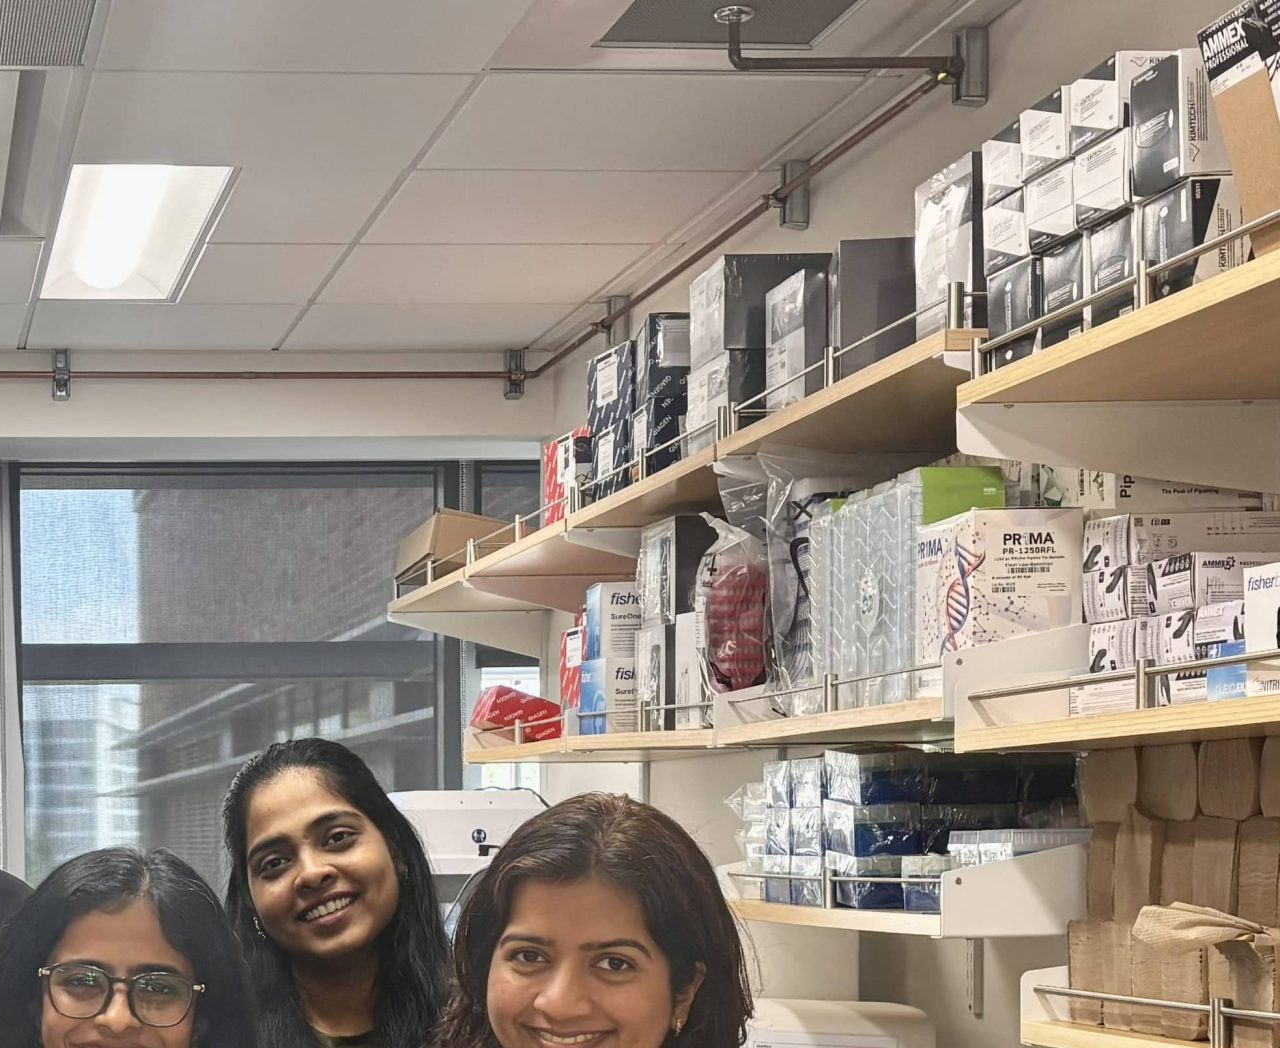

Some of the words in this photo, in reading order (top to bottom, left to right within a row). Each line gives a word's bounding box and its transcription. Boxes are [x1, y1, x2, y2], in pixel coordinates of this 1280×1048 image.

[1202, 18, 1247, 61] AMMEX
[1206, 38, 1249, 71] PROFESSIONAL
[1187, 102, 1196, 141] KIMTECH
[1002, 546, 1056, 555] PR-1250RFL
